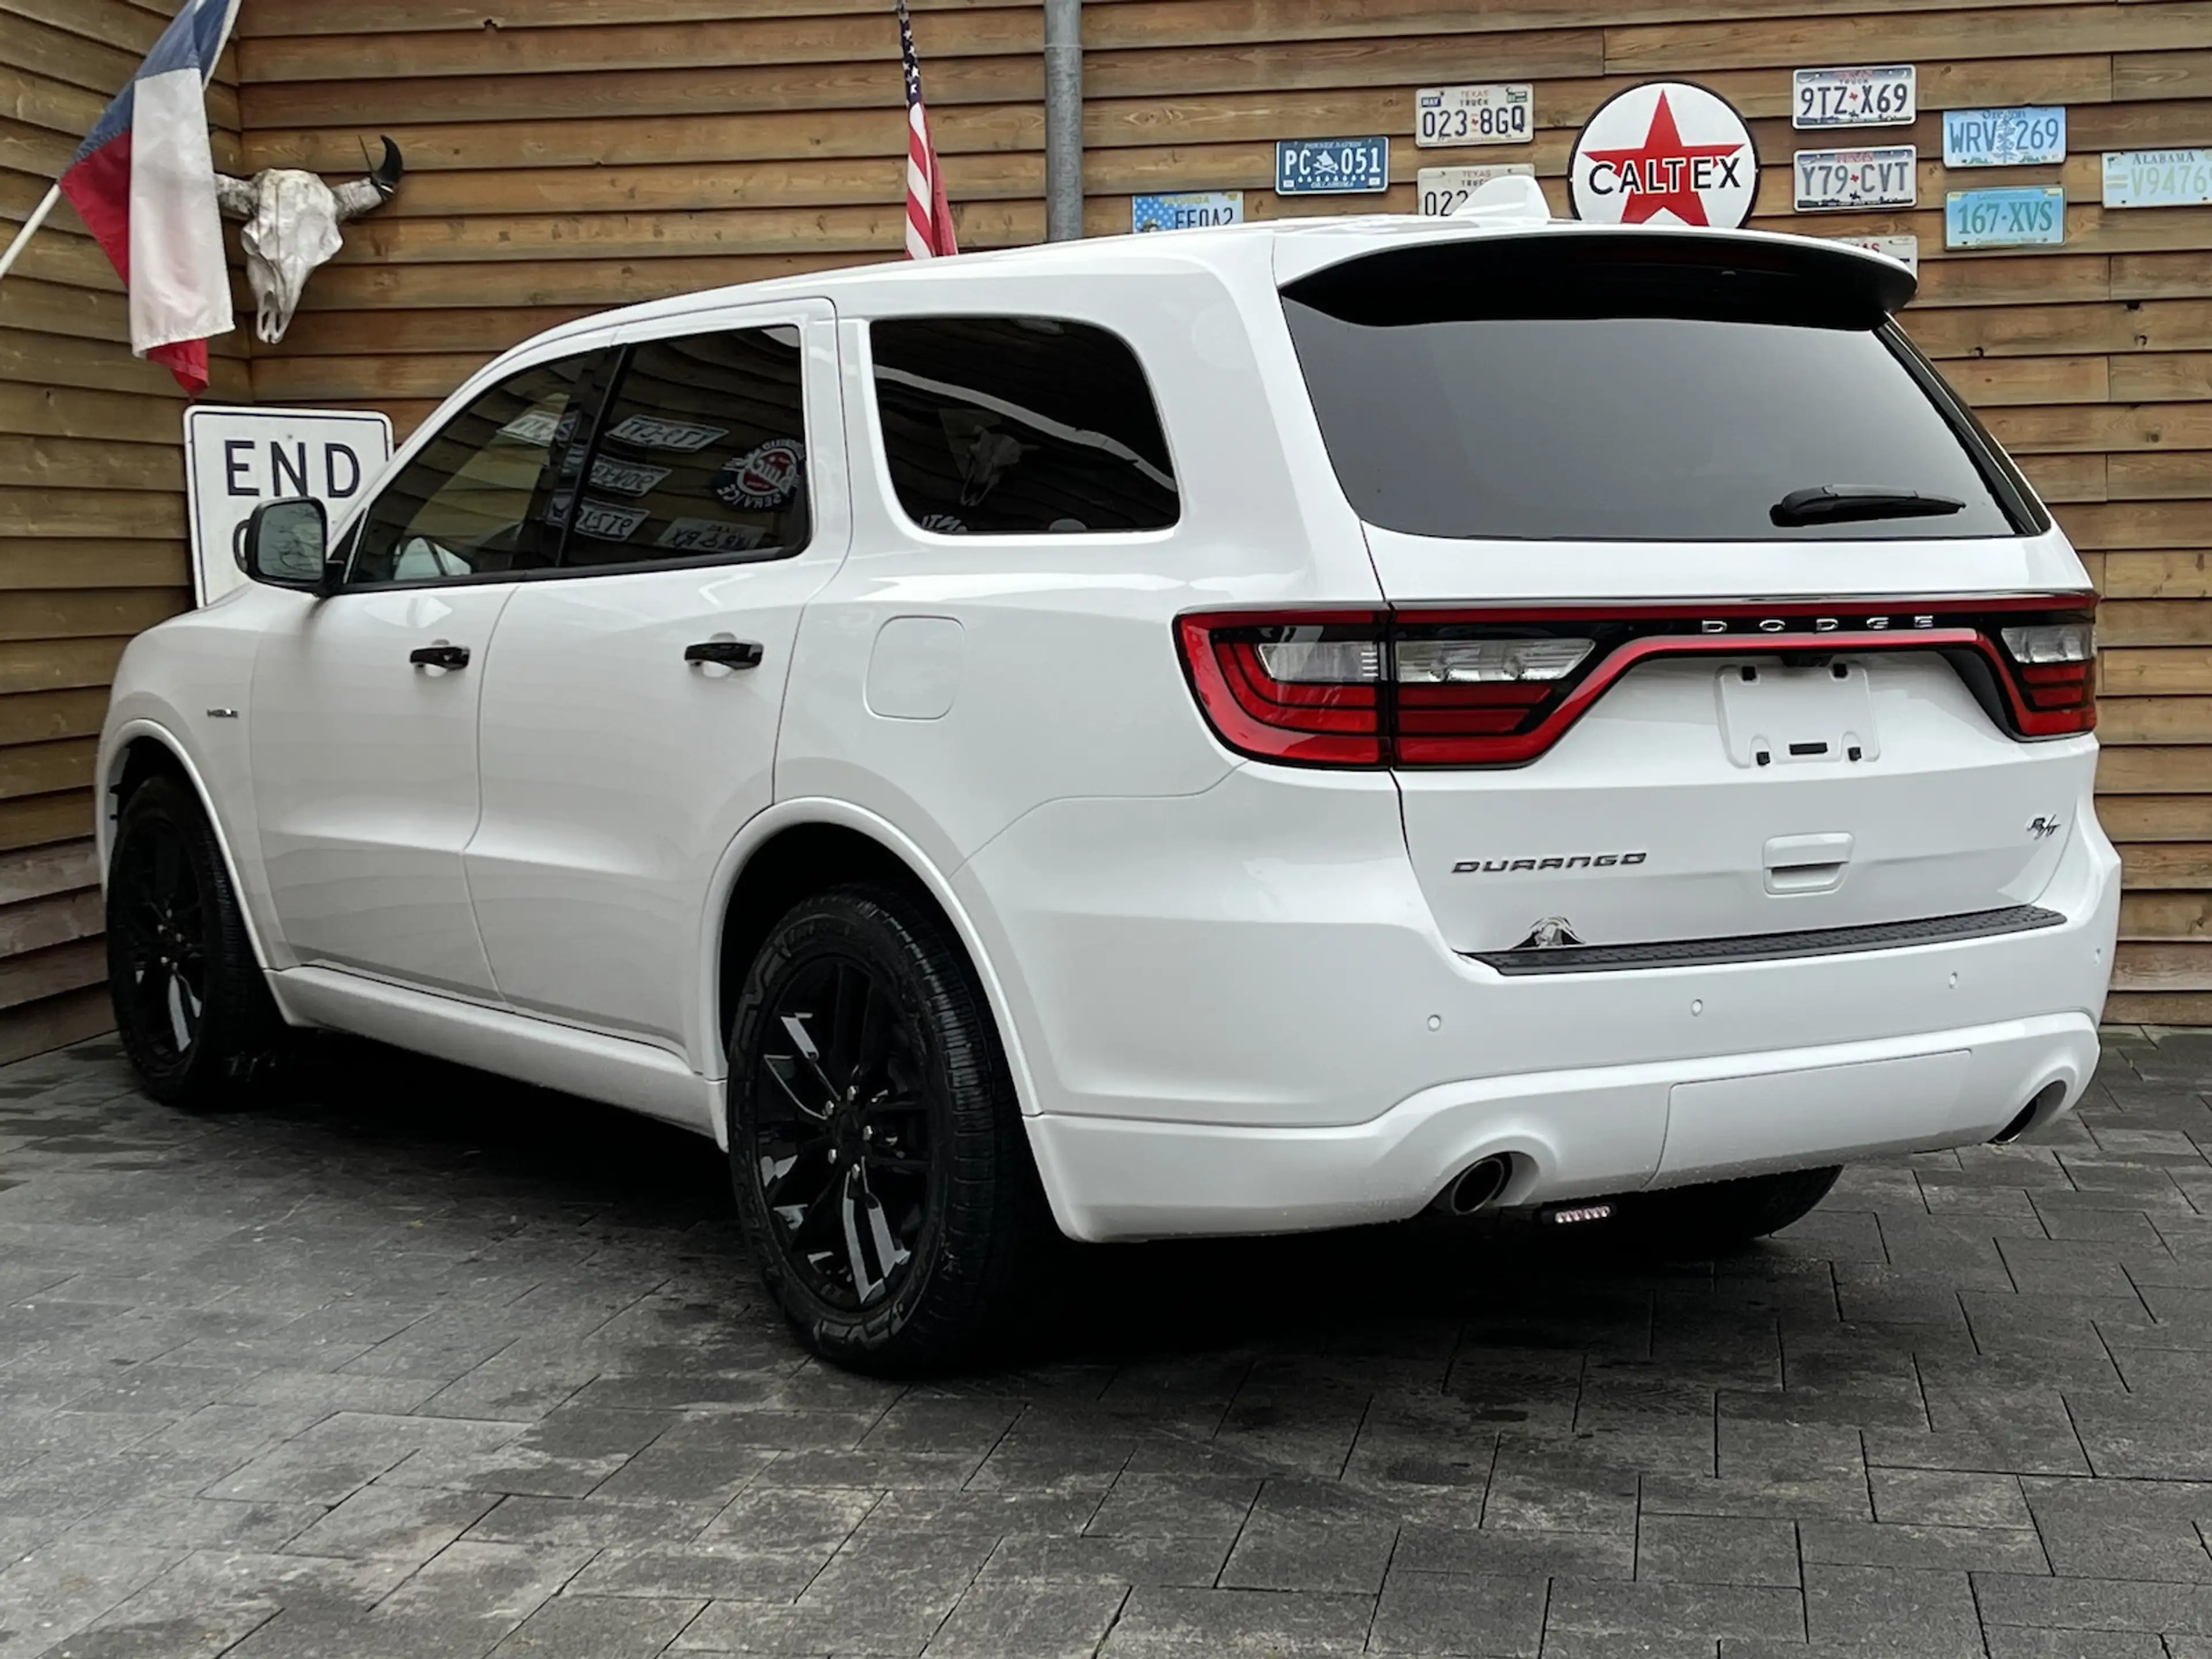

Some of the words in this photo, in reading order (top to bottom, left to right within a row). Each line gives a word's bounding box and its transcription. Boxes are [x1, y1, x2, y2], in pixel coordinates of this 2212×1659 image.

[1460, 98, 1488, 107] TRUCK
[1801, 86, 1848, 116] 9TZ
[1861, 83, 1907, 113] X69
[1423, 109, 1467, 138] 023
[1480, 105, 1524, 135] 8GQ
[1950, 120, 1997, 153] WRV
[2016, 118, 2059, 150] 269
[1285, 149, 1311, 176] PC
[1341, 147, 1381, 175] 051
[1462, 169, 1491, 178] TEXAS
[2133, 151, 2195, 165] ALABAMA
[1461, 179, 1488, 187] TRUC
[1589, 157, 1741, 195] CALTEX
[1801, 165, 1849, 196] Y79
[1861, 162, 1909, 192] CVT
[2131, 164, 2212, 197] V9476
[224, 439, 361, 498] END
[1701, 615, 1934, 634] DODGE
[1450, 852, 1647, 873] DURANGO
